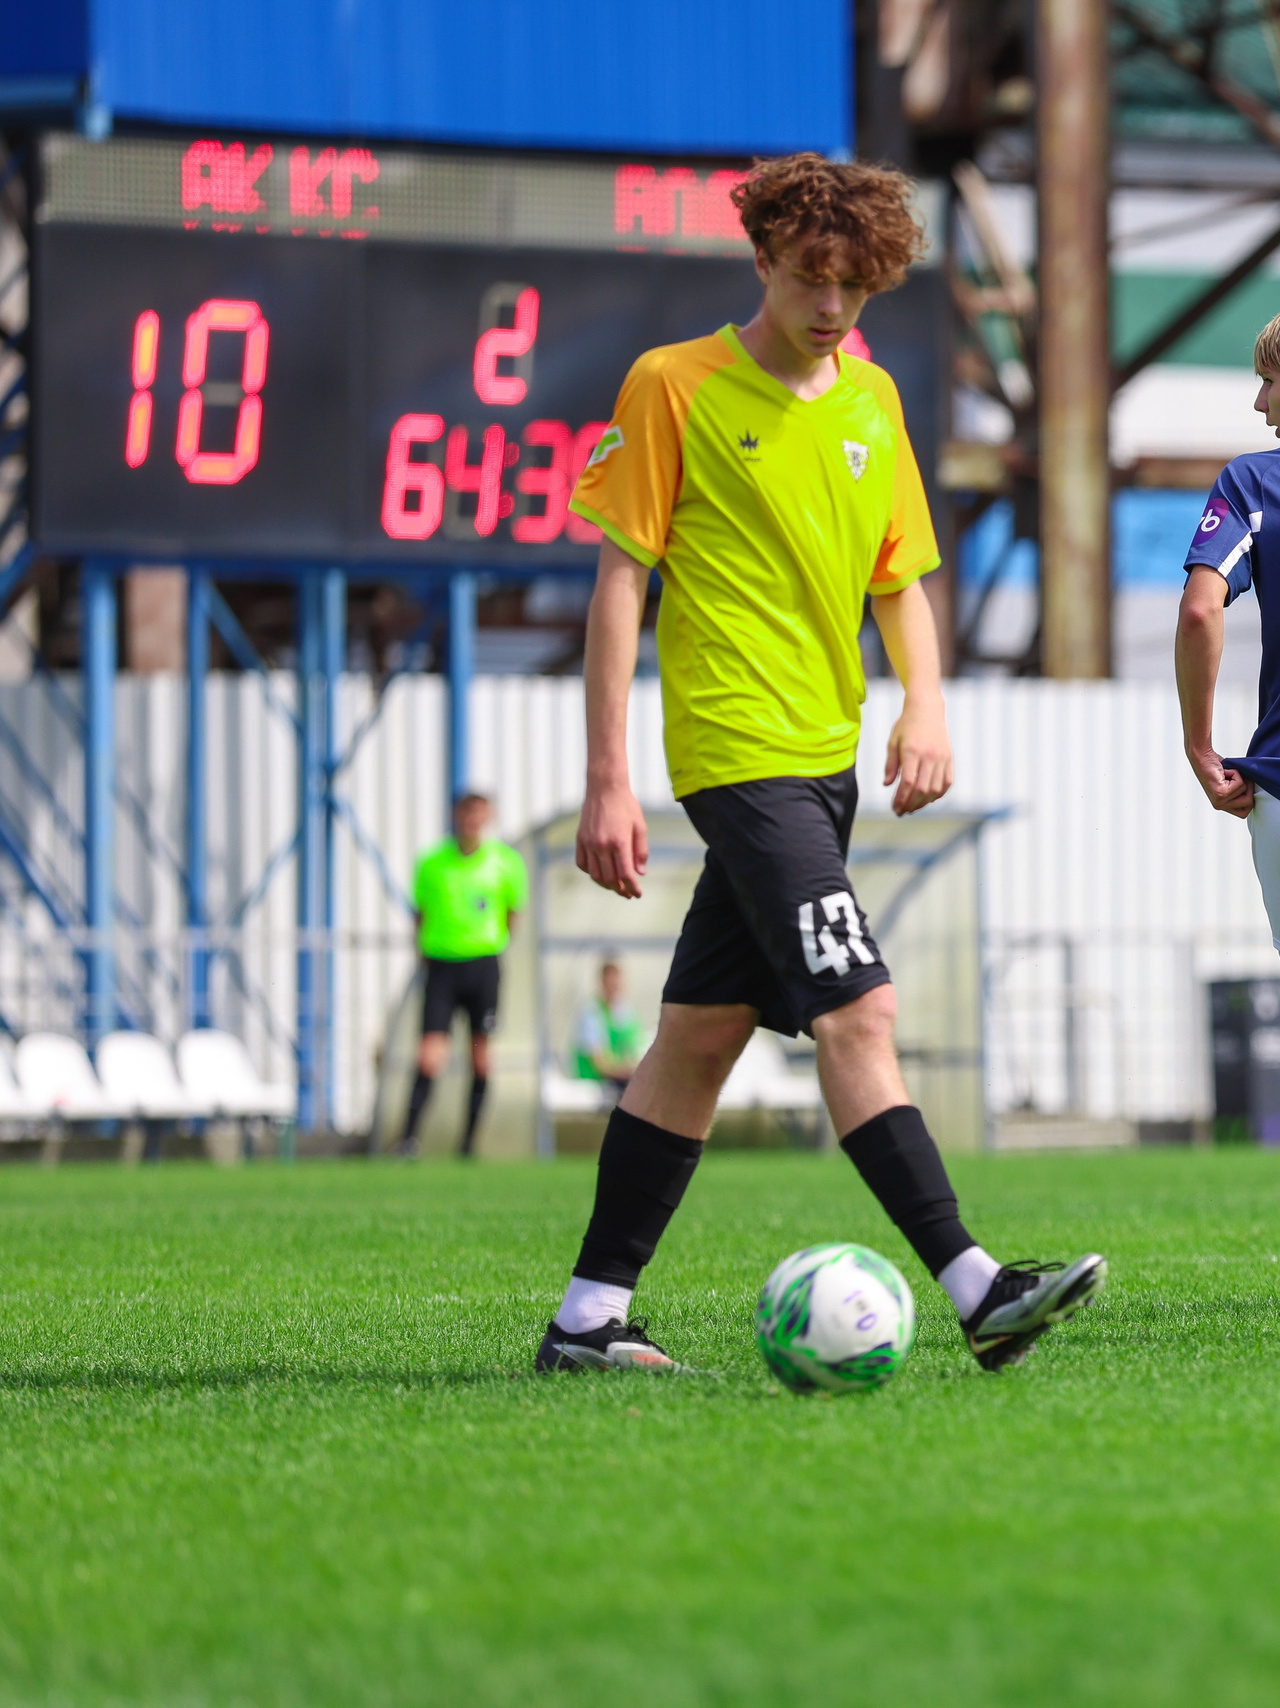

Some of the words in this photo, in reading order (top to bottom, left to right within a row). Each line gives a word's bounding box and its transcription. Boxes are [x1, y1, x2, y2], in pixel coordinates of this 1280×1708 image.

[126, 299, 270, 485] 10
[473, 286, 540, 405] 2
[798, 891, 876, 977] 47
